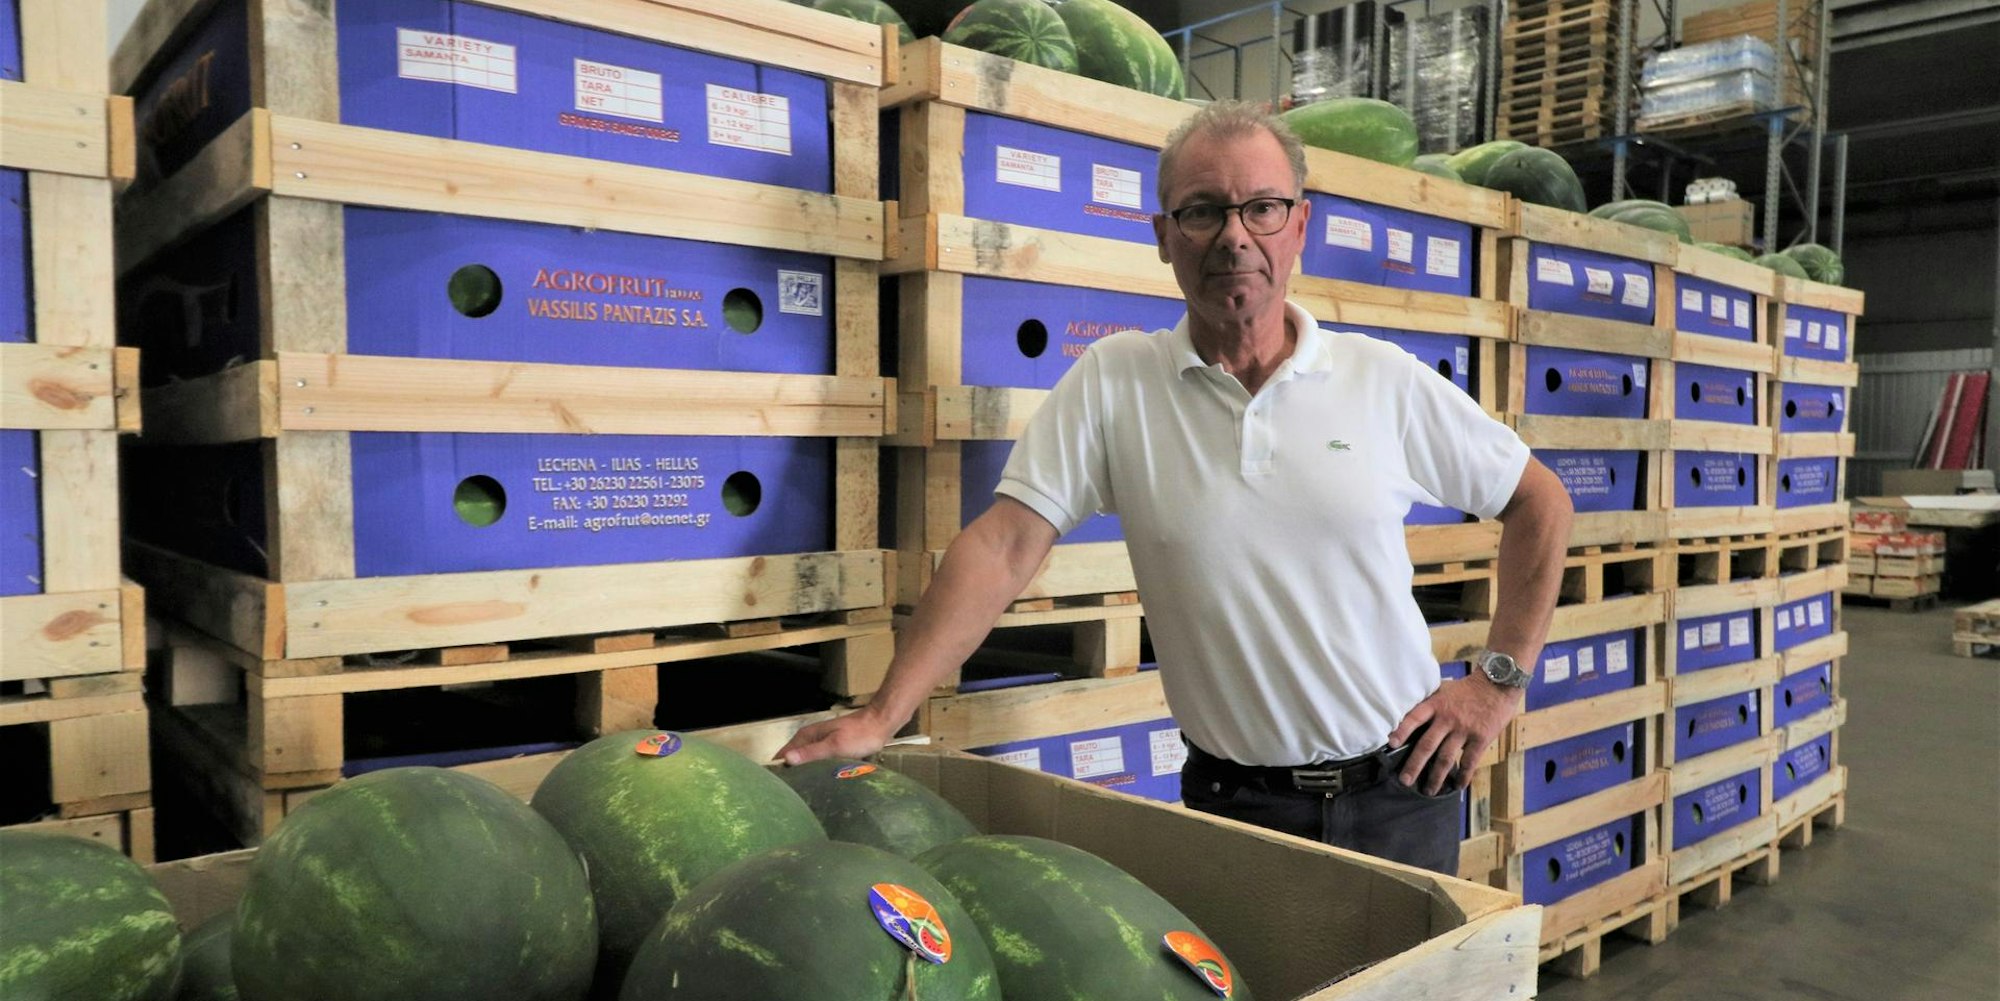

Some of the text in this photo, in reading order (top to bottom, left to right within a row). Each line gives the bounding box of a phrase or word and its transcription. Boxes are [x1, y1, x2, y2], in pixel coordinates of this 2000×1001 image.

[423, 35, 493, 54] VARIETY
[404, 48, 469, 64] SAMANTA
[580, 64, 622, 80] BRUTO
[581, 80, 612, 94] TARA
[581, 95, 605, 107] NET
[721, 89, 776, 106] CALIBRE
[1010, 151, 1048, 163] VARIETY
[1095, 167, 1119, 178] BRUTO
[1095, 179, 1113, 188] TARA
[532, 268, 667, 298] AGROFRUT
[528, 298, 708, 328] VASSILIS PANTAZIS S.A.
[537, 457, 597, 472] LECHENA
[611, 457, 642, 472] ILIAS
[655, 456, 699, 471] HELLAS
[563, 477, 587, 491] +30
[588, 477, 626, 491] 26230
[628, 475, 705, 490] 22561-23075
[552, 493, 689, 510] FAX: +30 26230 23292
[528, 512, 711, 532] E-mail: agrofrut@otenet.gr
[995, 752, 1028, 763] ARIETY
